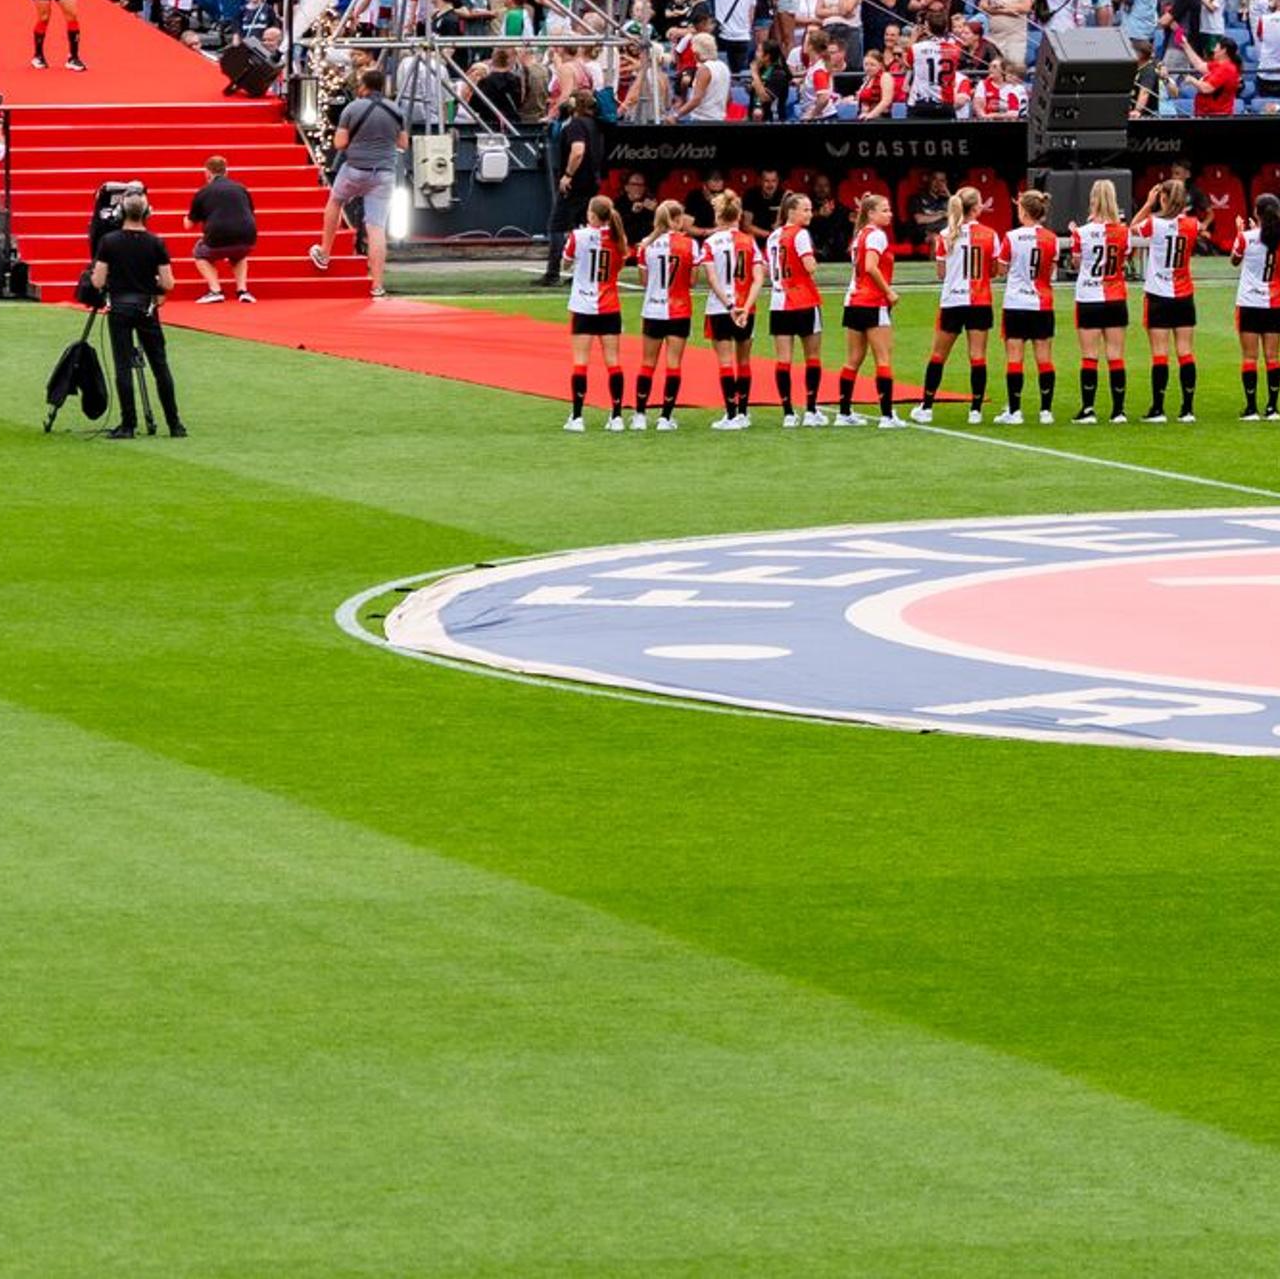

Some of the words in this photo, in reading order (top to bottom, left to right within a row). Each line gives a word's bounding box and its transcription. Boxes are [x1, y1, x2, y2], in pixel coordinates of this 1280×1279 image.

[926, 57, 954, 86] 12
[858, 139, 970, 157] CASTORE
[589, 248, 611, 282] 19
[723, 249, 746, 286] 14
[961, 244, 982, 280] 10
[1030, 247, 1041, 280] 9
[1091, 244, 1118, 277] 26
[1164, 235, 1186, 269] 18
